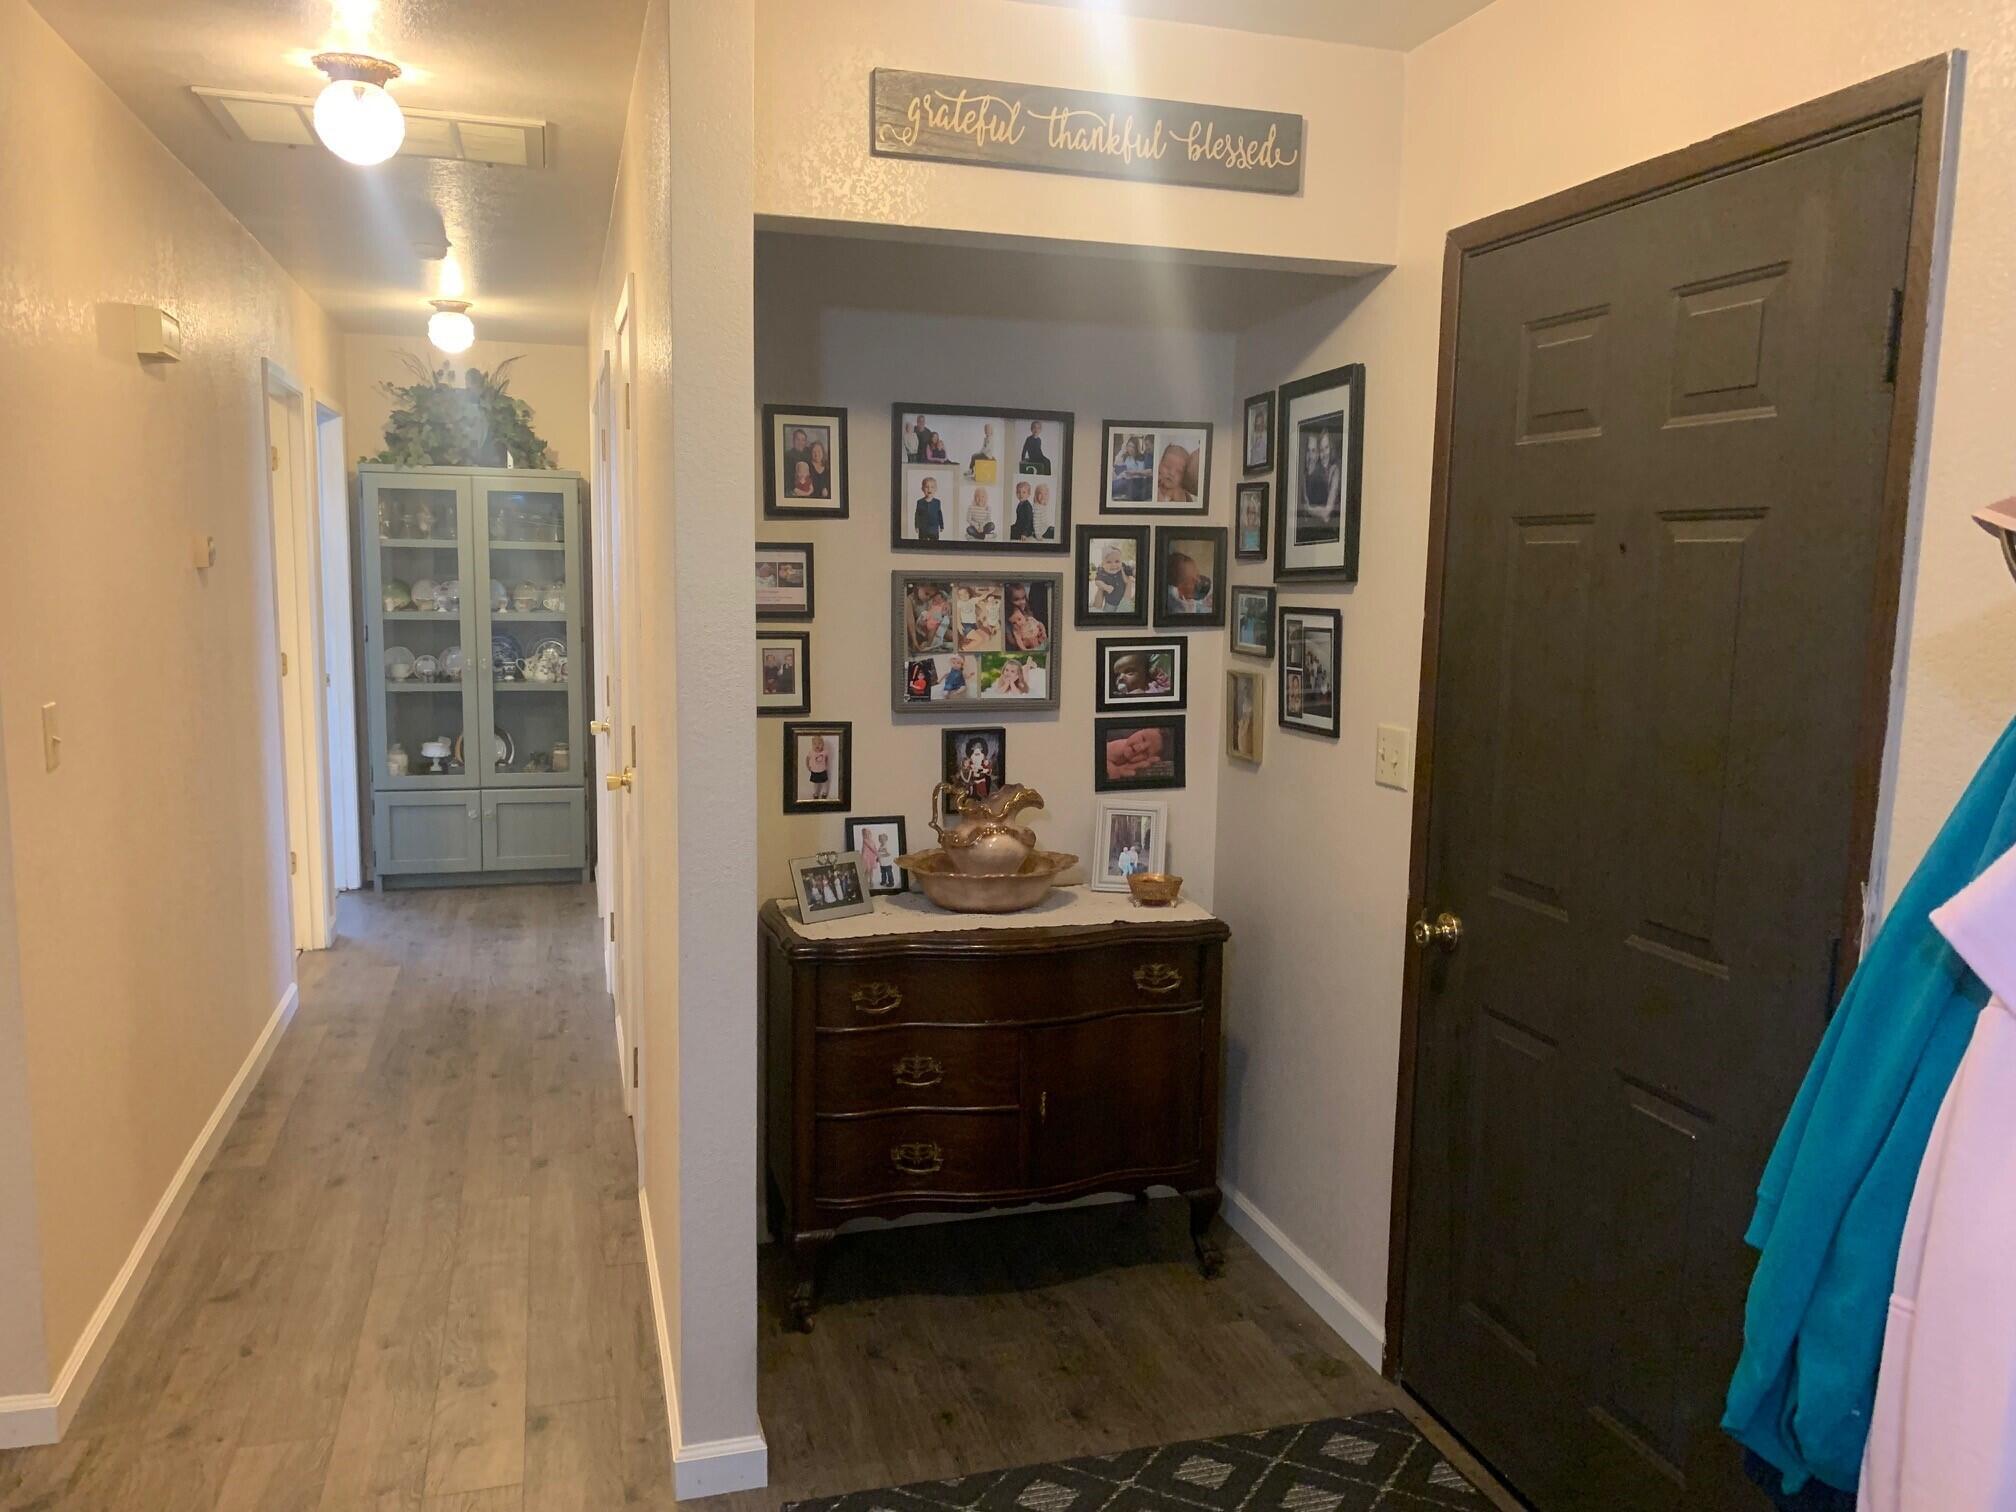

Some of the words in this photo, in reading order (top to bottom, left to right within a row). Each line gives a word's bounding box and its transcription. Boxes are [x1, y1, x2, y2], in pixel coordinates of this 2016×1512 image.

[879, 88, 1025, 146] grateful
[1028, 105, 1167, 163] thankful
[1170, 121, 1298, 169] blessed
